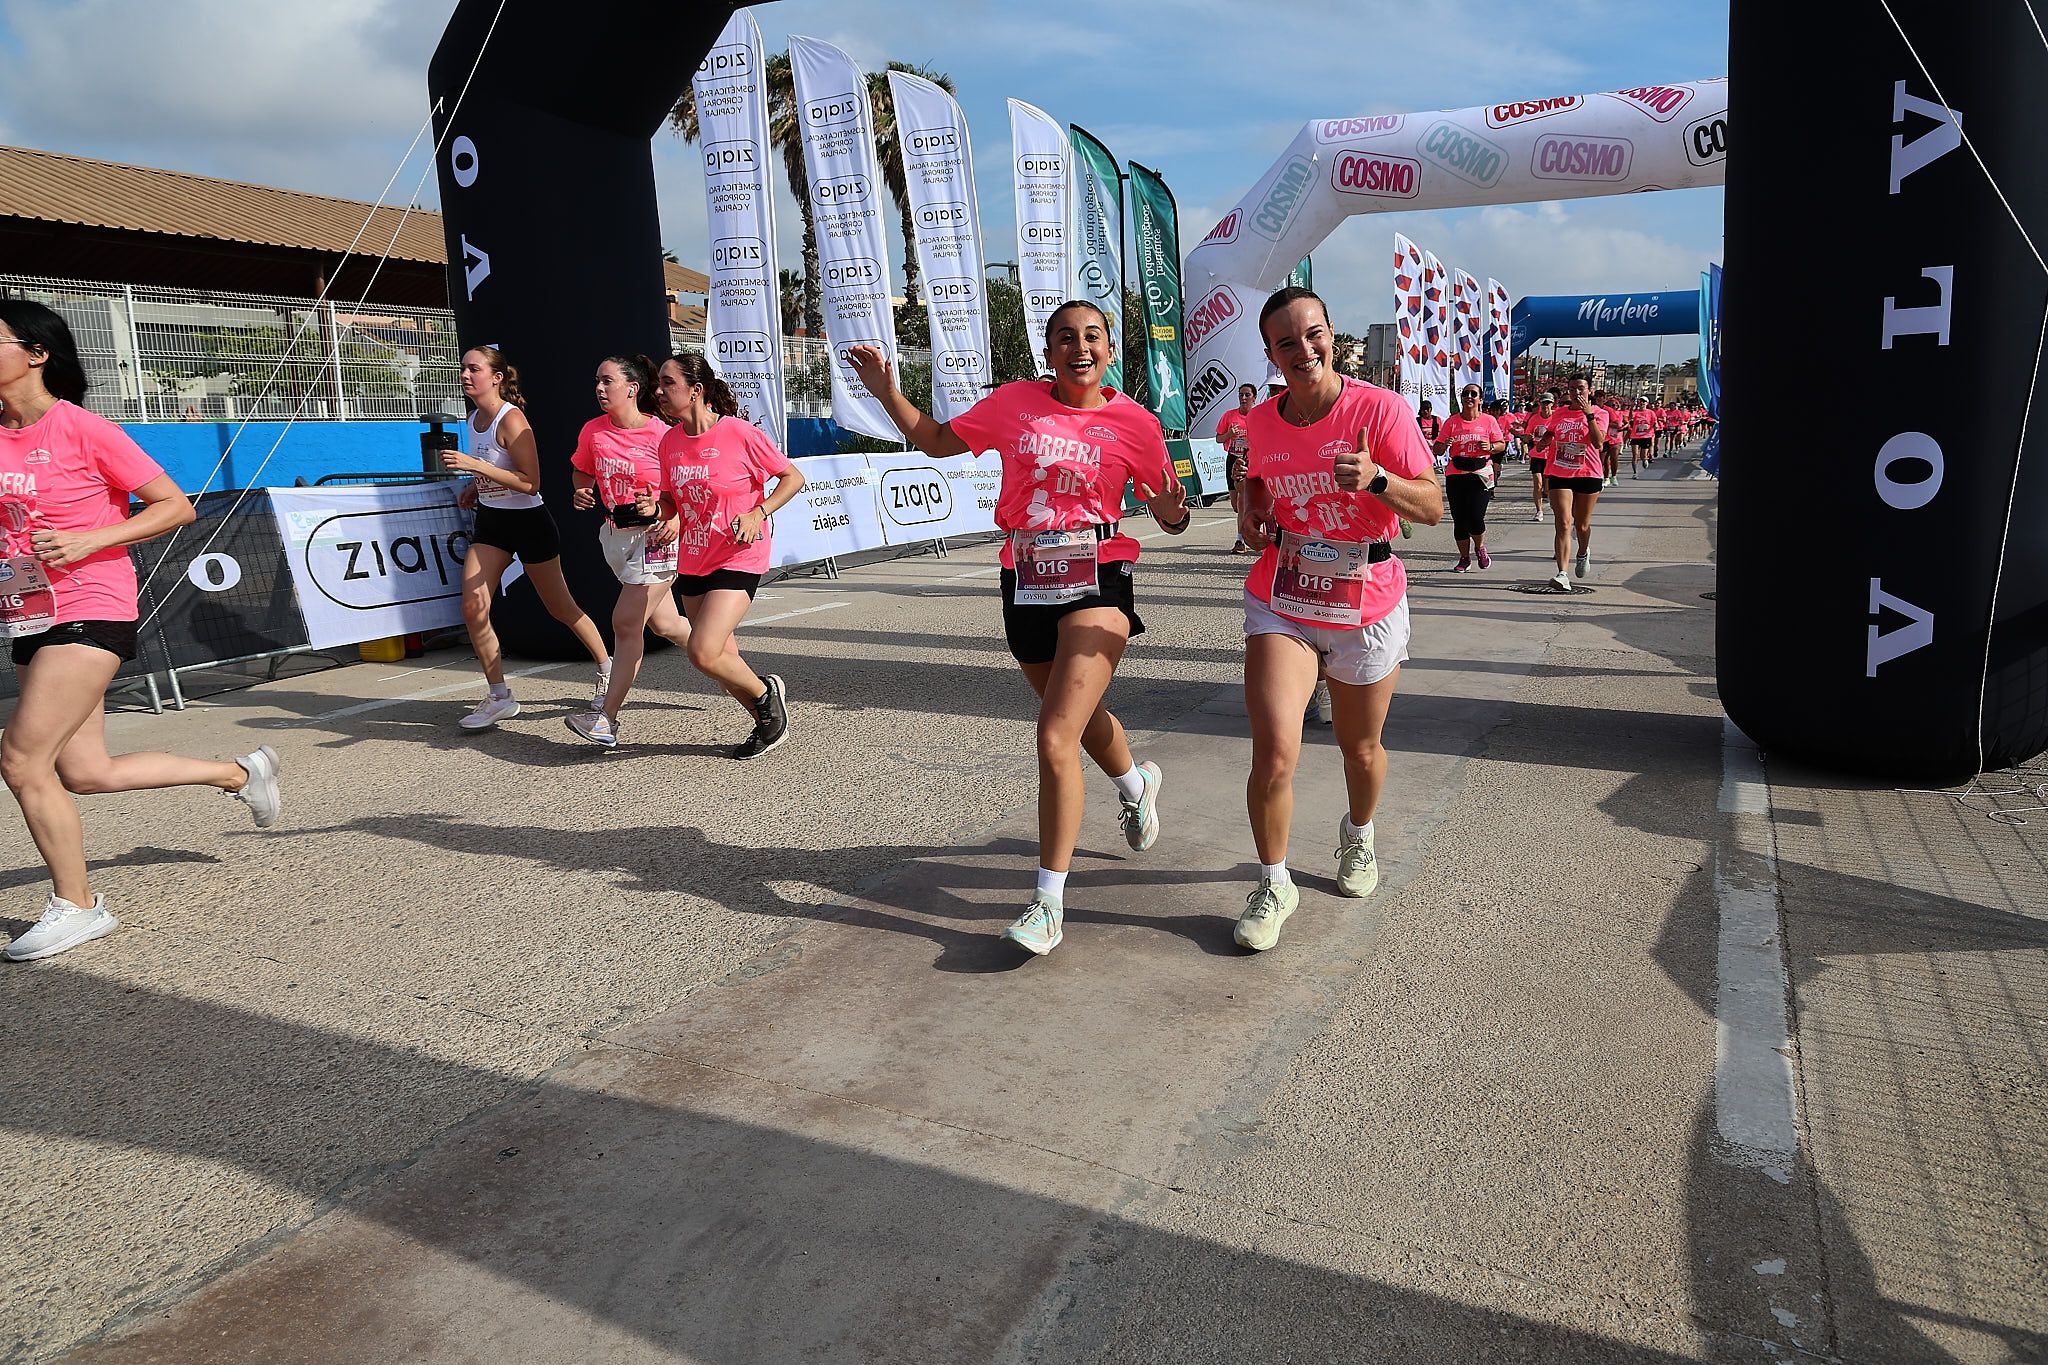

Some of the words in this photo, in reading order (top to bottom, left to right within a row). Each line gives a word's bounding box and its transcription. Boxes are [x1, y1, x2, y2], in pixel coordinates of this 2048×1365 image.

[1494, 96, 1576, 122] COSMO
[1324, 116, 1398, 138] COSMO
[1425, 126, 1499, 182] COSMO
[1540, 140, 1625, 176] COSMO
[1339, 156, 1414, 194] COSMO
[1256, 160, 1313, 234] COSMO
[1184, 291, 1235, 351] COSMO
[1577, 297, 1659, 331] Marlene
[1020, 412, 1055, 426] OYSHO
[1018, 432, 1101, 467] CARRERA
[1261, 452, 1290, 464] OYSHO
[596, 457, 636, 476] CARRERA
[835, 476, 867, 488] CORPORAL
[1056, 468, 1082, 497] DE
[807, 499, 813, 508] Y
[815, 495, 841, 507] CAPILAR
[890, 482, 943, 515] ziaja
[813, 513, 849, 531] ziaja.es
[1317, 502, 1350, 532] DE
[1037, 535, 1067, 545] ASTURIANA
[1301, 547, 1336, 559] ASTURIANA
[1036, 560, 1069, 575] 016
[1298, 574, 1333, 591] 016
[0, 594, 24, 608] 16
[1062, 591, 1089, 599] Santander
[1279, 592, 1296, 602] CARRERA
[1310, 598, 1326, 606] MUJER
[1278, 602, 1304, 614] OYSHO
[1321, 611, 1351, 619] Santander
